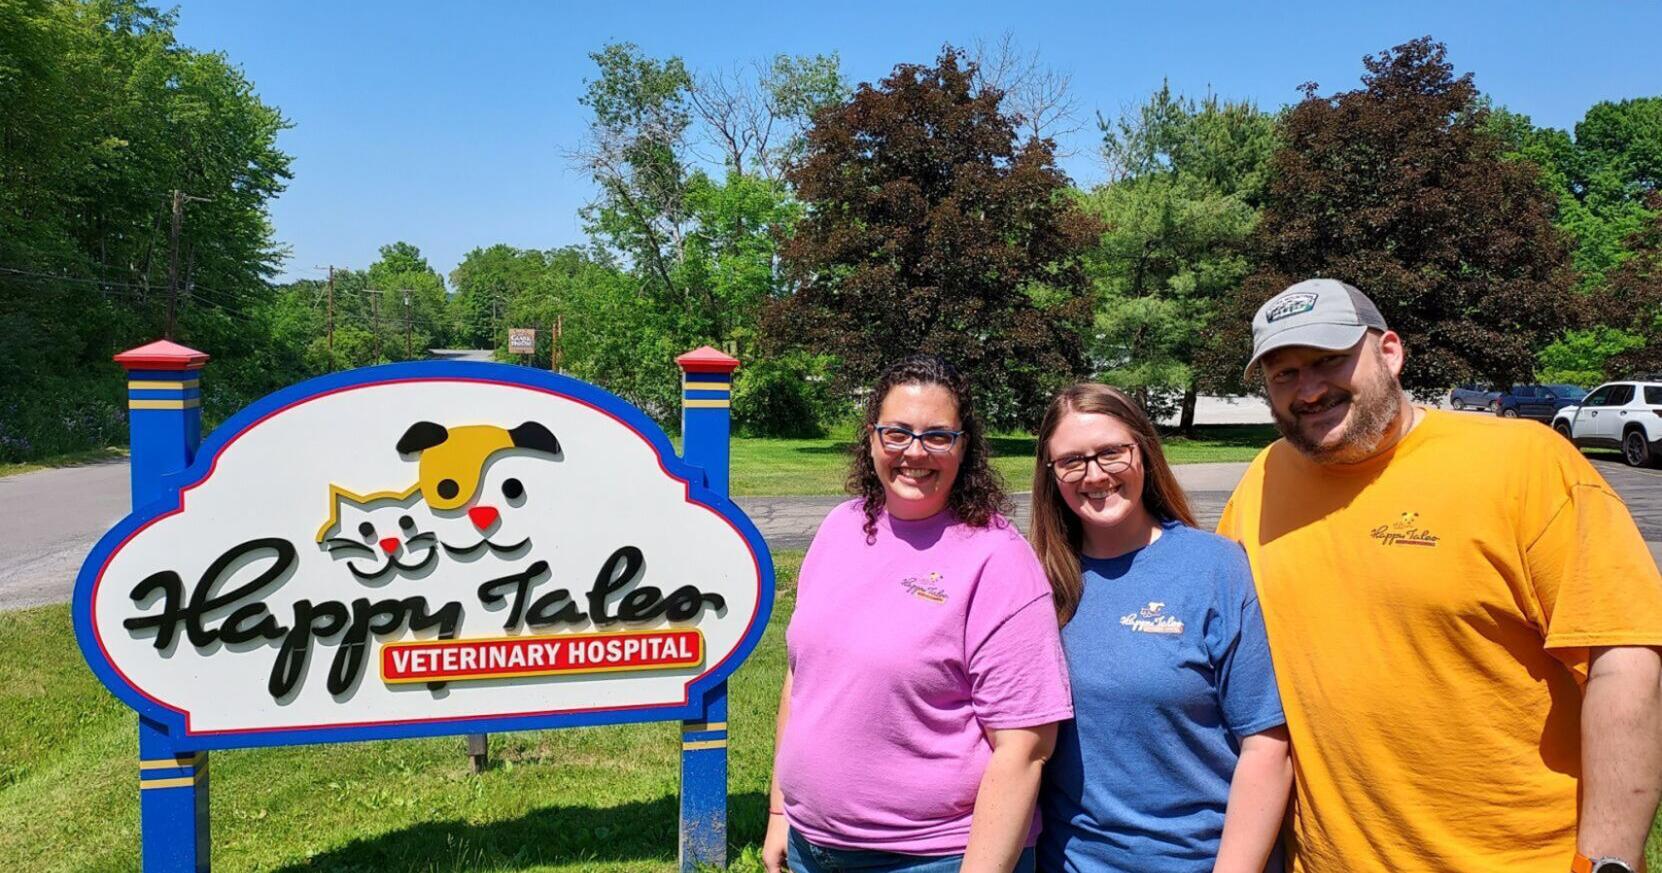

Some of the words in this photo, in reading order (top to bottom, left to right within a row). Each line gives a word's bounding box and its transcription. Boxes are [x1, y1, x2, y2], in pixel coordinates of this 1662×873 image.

[124, 538, 463, 698] Happy
[478, 546, 725, 629] Tales
[392, 642, 560, 672] VETERINARY
[568, 637, 692, 664] HOSPITAL
